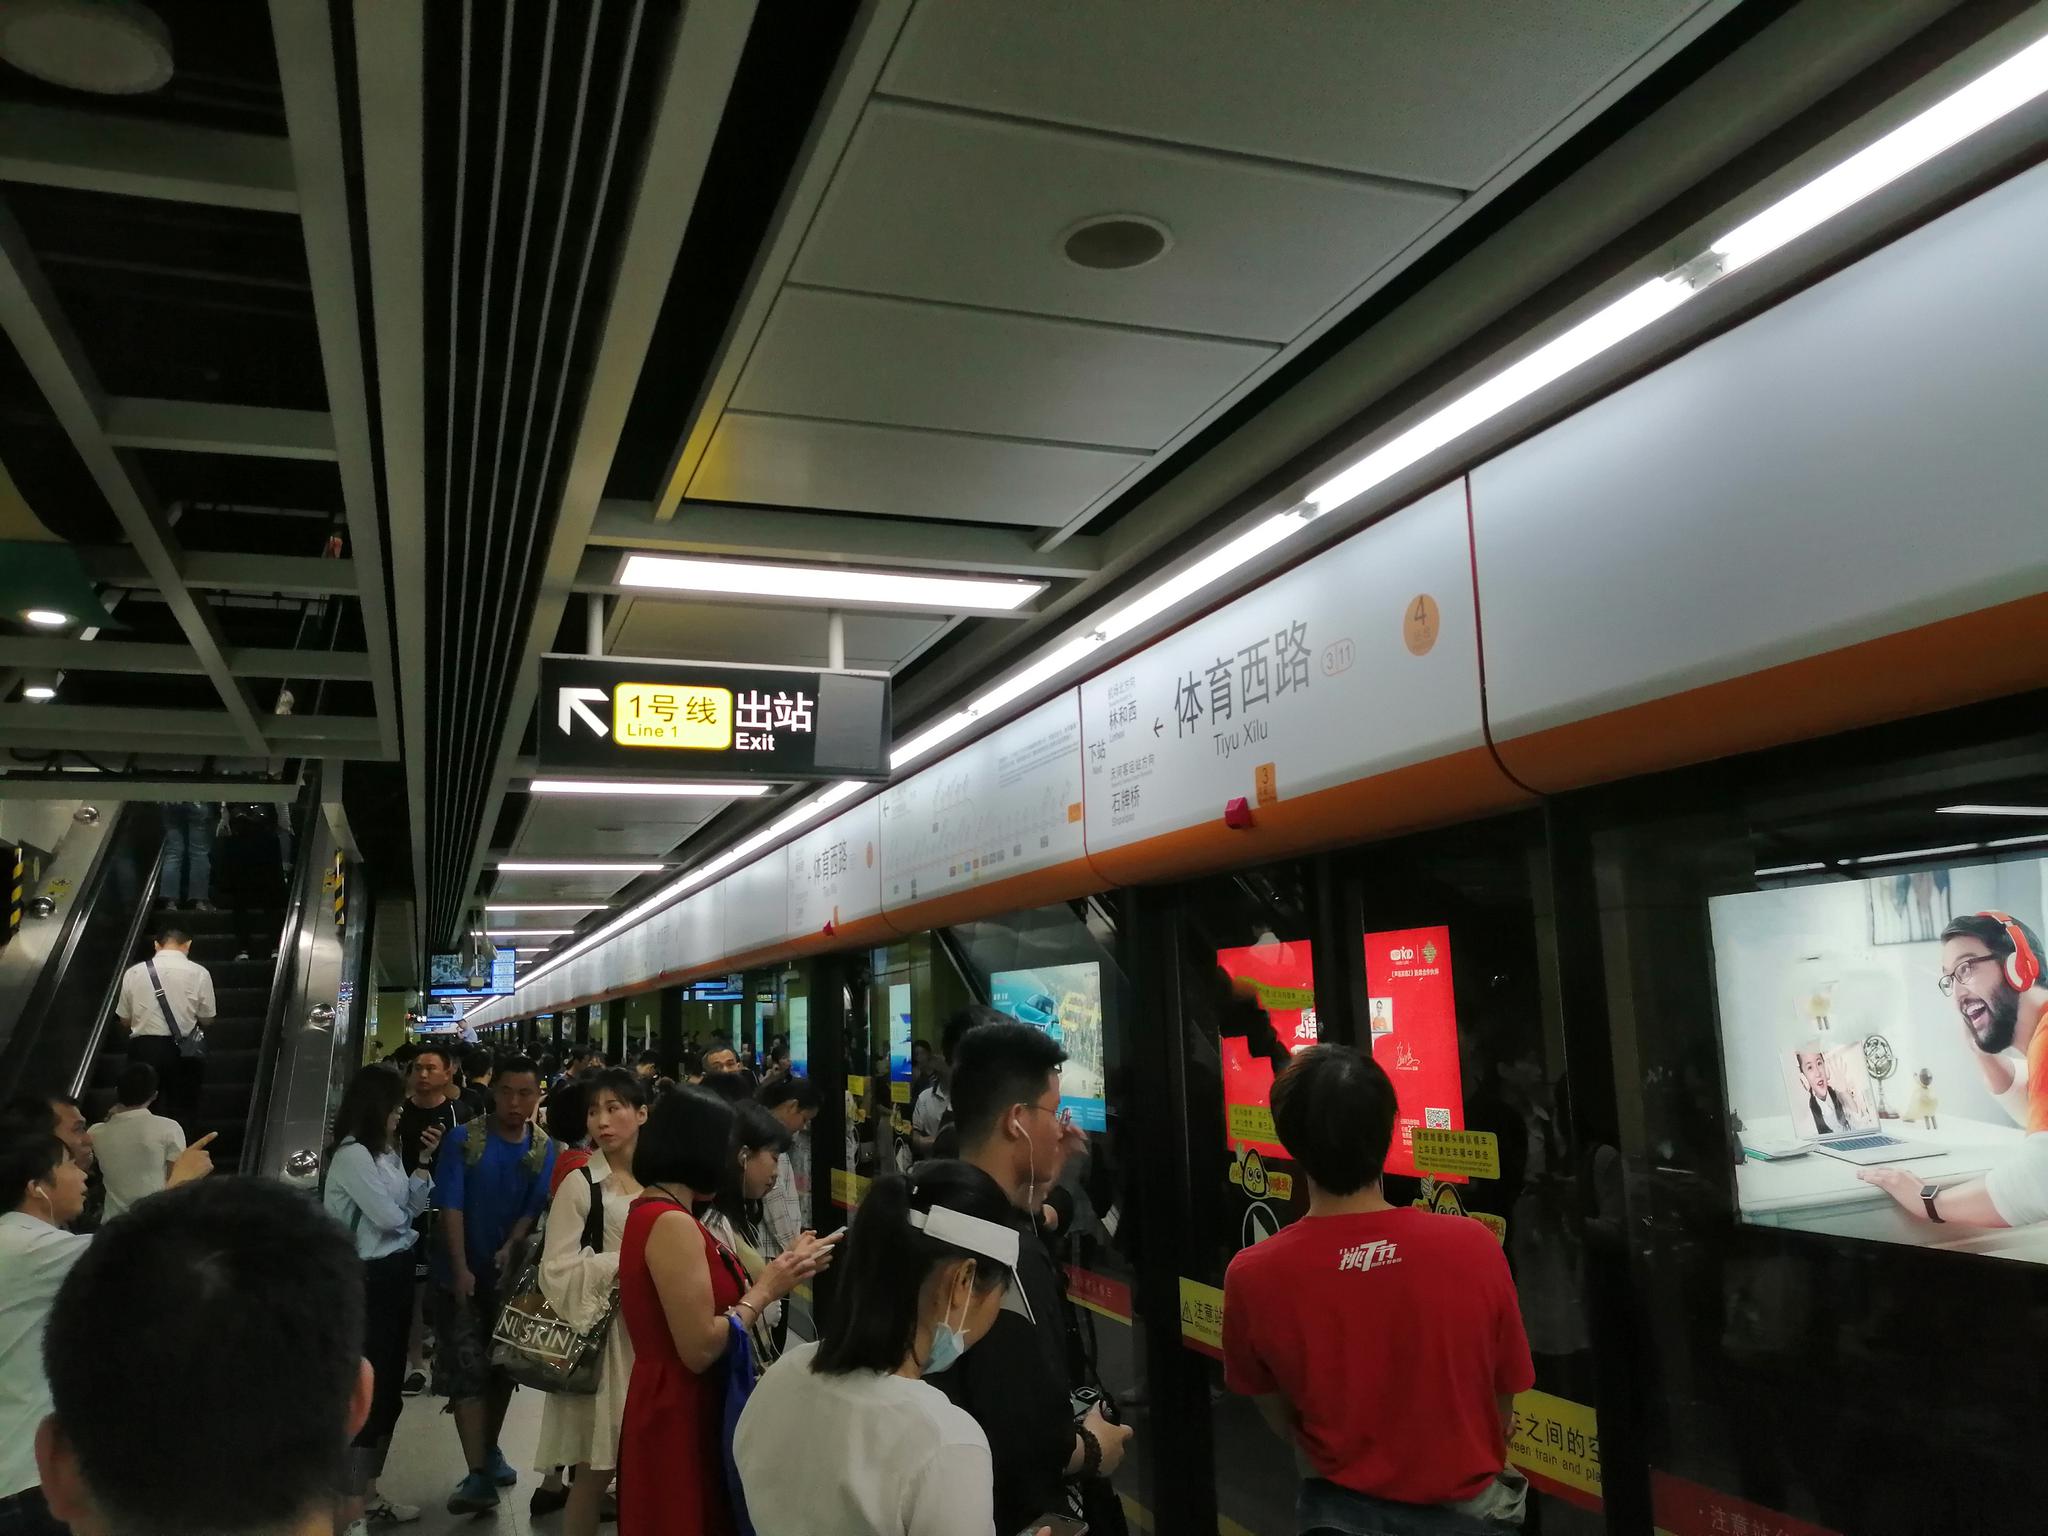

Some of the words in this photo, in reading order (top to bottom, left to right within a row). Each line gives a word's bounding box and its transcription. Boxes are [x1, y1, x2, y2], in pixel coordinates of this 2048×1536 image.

[1414, 594, 1427, 626] 4
[1175, 620, 1312, 738] 体育西路
[628, 694, 717, 725] 1号线
[735, 690, 814, 733] 出站
[1109, 700, 1136, 731] 林和西
[627, 723, 665, 738] Line
[670, 725, 678, 739] 1
[735, 733, 776, 751] Exit
[1213, 731, 1240, 760] Tiyu
[1243, 718, 1268, 748] Xilu
[1262, 767, 1269, 785] 3
[1535, 1448, 1558, 1465] train
[1562, 1459, 1581, 1475] and
